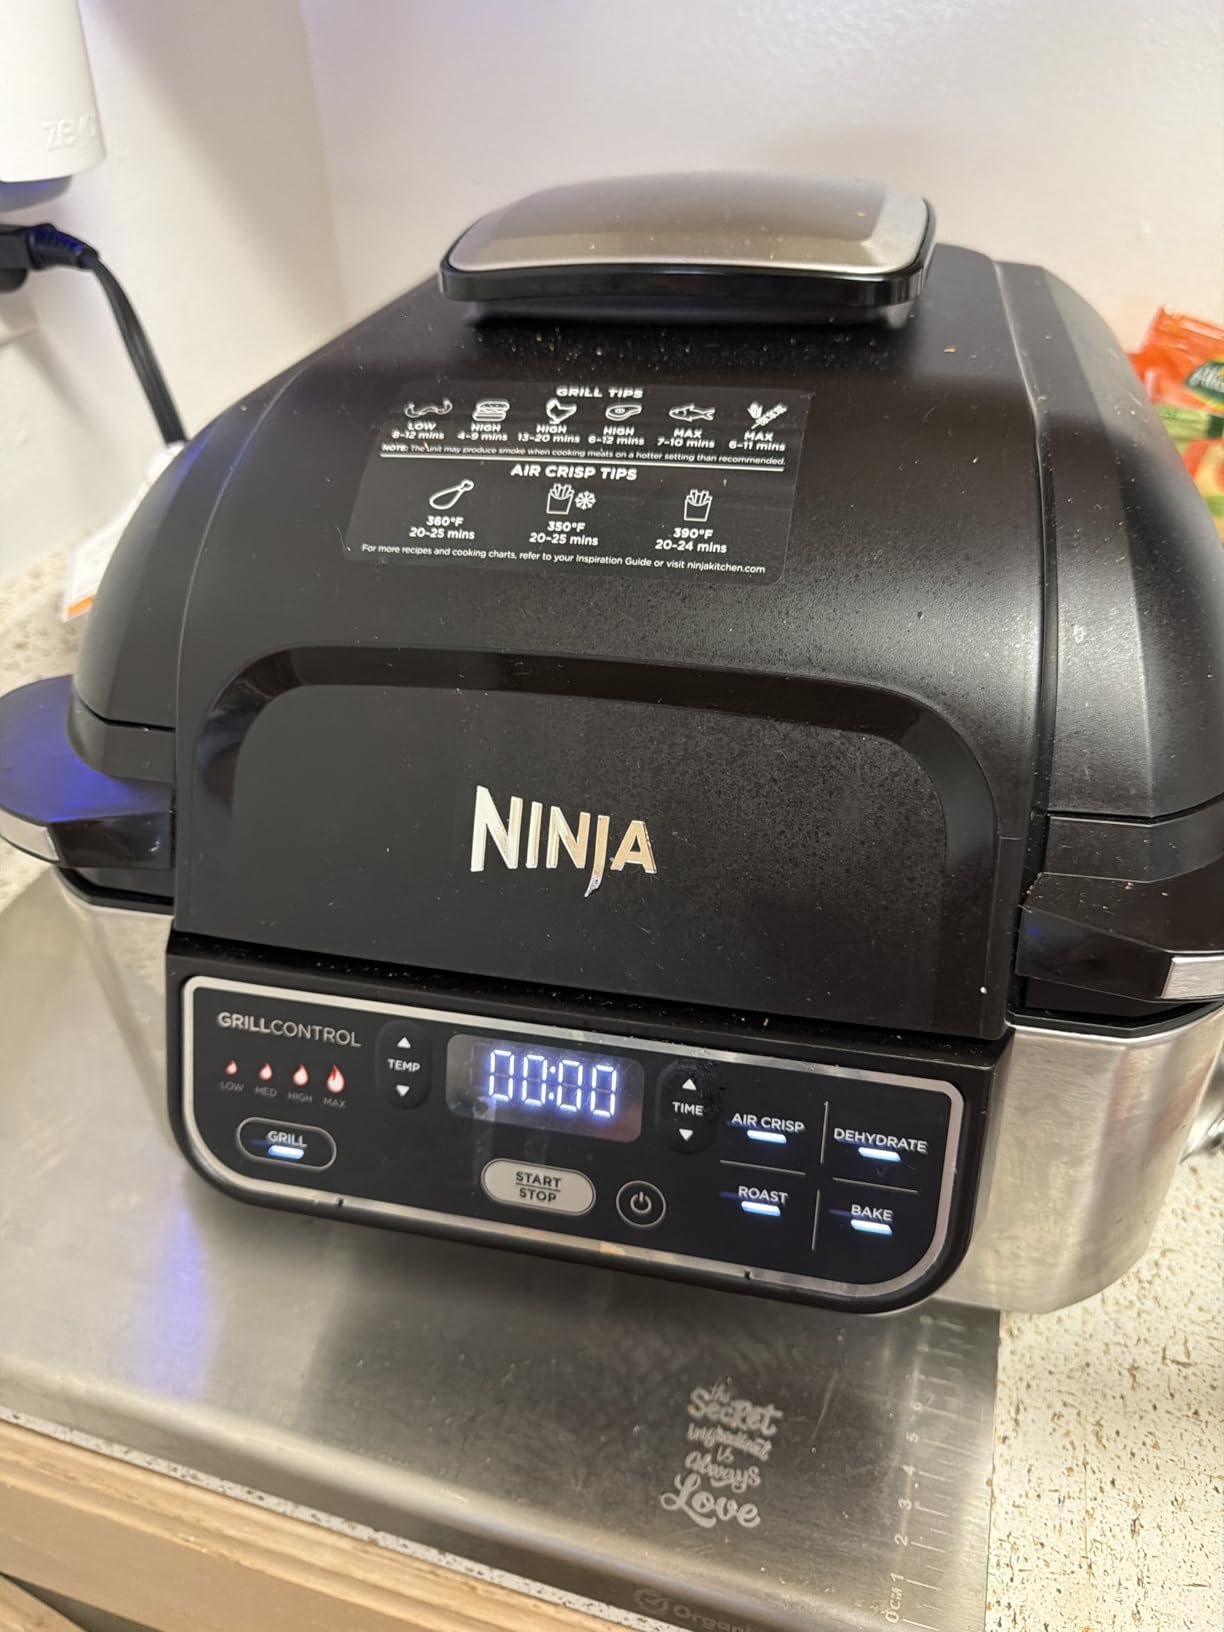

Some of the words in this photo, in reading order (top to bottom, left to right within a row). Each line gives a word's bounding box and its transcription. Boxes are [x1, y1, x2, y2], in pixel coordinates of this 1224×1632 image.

[556, 386, 602, 398] GRILL
[608, 388, 644, 399] TIPS
[407, 422, 436, 431] LOW
[471, 423, 501, 432] HIGH
[536, 424, 567, 434] HIGH
[603, 426, 634, 436] HIGH
[673, 428, 702, 438] MAX
[418, 430, 445, 440] mins
[457, 431, 479, 441] 4-9
[480, 432, 508, 442] mins
[517, 433, 550, 443] 13-20
[552, 434, 581, 444] mins
[588, 436, 614, 445] 6-12
[616, 435, 645, 446] mins
[744, 431, 774, 442] MAX
[657, 438, 684, 447] 7-10
[686, 438, 715, 449] mins
[729, 441, 752, 450] 6-11
[755, 441, 786, 452] mins
[381, 443, 408, 452] NOTE:
[410, 443, 425, 452] The
[426, 445, 442, 453] unit
[444, 446, 461, 454] may
[462, 445, 497, 454] produce
[499, 447, 526, 455] smoke
[527, 447, 550, 456] when
[552, 448, 586, 458] cooking
[587, 450, 613, 458] meats
[635, 451, 662, 460] hotter
[664, 452, 695, 463] setting
[697, 453, 717, 462] than
[719, 455, 786, 465] recommended.
[510, 464, 541, 477] AIR
[545, 465, 596, 479] CRISP
[600, 467, 638, 481] TIPS
[547, 521, 586, 532] 350°F
[409, 527, 445, 538] 20-25
[447, 529, 475, 540] mins
[529, 533, 567, 544] 20-25
[569, 534, 598, 546] mins
[655, 539, 694, 551] 20-24
[697, 541, 727, 553] mins
[361, 543, 376, 552] For
[378, 545, 400, 553] more
[401, 546, 432, 556] recipes
[433, 547, 451, 556] and
[452, 548, 487, 559] cooking
[488, 550, 517, 559] charts,
[519, 551, 540, 560] refer
[542, 552, 552, 560] to
[553, 554, 574, 563] your
[576, 554, 623, 565] Inspiration
[625, 557, 652, 567] Guide
[666, 559, 685, 568] visit
[687, 561, 766, 574] ninjakitchen.com
[470, 785, 658, 898] NINJA
[216, 1012, 362, 1047] GRILLCONTROL
[387, 1058, 421, 1072] TEMP
[220, 1081, 244, 1092] LOW
[488, 1049, 617, 1118] 00:00
[254, 1086, 277, 1097] MED
[288, 1091, 313, 1103] HIGH
[323, 1097, 347, 1109] MAX
[672, 1101, 704, 1116] TIME
[731, 1113, 758, 1127] AIR
[760, 1116, 805, 1133] CRISP
[266, 1130, 308, 1147] GRILL
[833, 1128, 928, 1153] DEHYDRATE
[515, 1171, 562, 1188] START
[519, 1187, 557, 1202] STOP
[738, 1186, 788, 1204] ROAST
[851, 1204, 893, 1221] BAKE
[906, 1432, 919, 1443] 5
[902, 1463, 916, 1477] 4
[660, 1472, 761, 1528] Love
[898, 1498, 912, 1510] 3
[894, 1533, 909, 1546] 2
